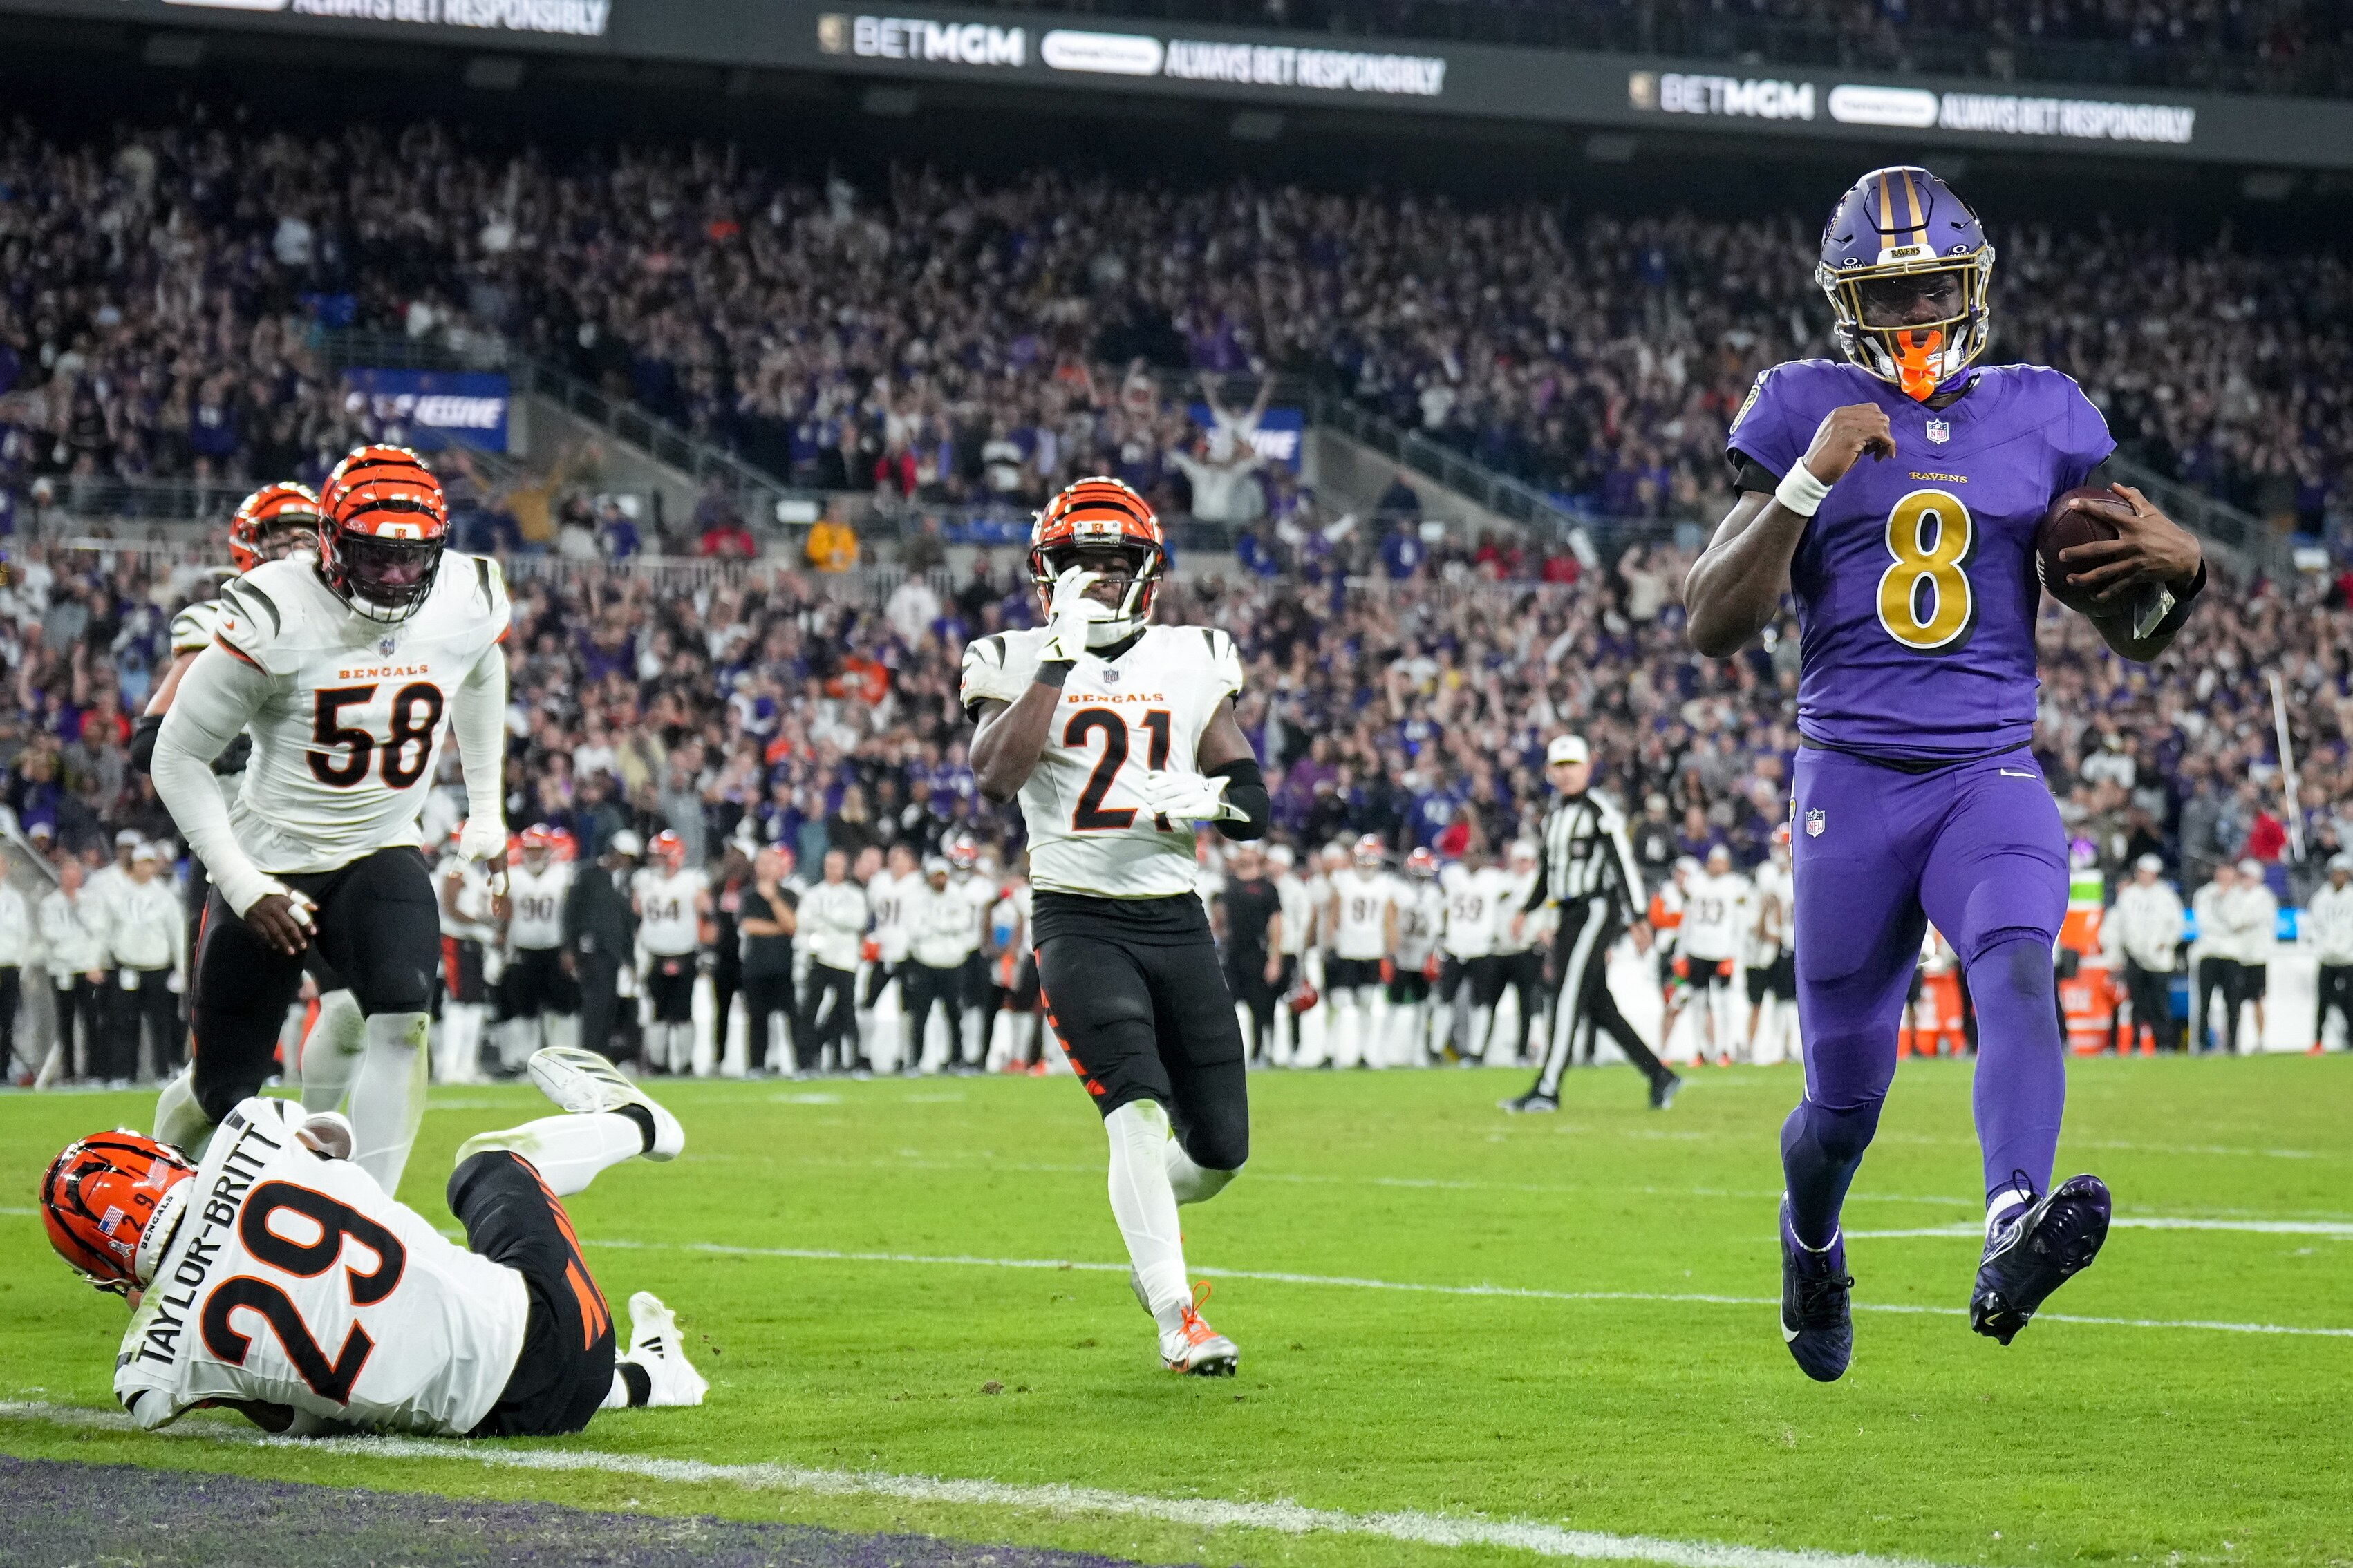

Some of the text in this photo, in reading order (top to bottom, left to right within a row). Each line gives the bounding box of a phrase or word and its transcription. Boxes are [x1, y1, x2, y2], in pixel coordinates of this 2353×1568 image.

[853, 15, 1026, 67] BETMGM
[1253, 44, 1297, 86] BET
[1297, 48, 1446, 95] RESPONSIBLY
[1660, 73, 1815, 121] BETMGM
[1891, 247, 1921, 258] RAVENS
[1909, 471, 1968, 484] RAVENS
[1876, 489, 1975, 651] 8
[339, 665, 429, 679] BENGALS
[1067, 693, 1164, 703] BENGALS
[306, 681, 444, 790] 58
[1062, 707, 1174, 833] 21
[122, 1193, 156, 1233] 29
[140, 1195, 174, 1250] BENGALS
[135, 1122, 282, 1366] TAYLOR-BRITT
[200, 1180, 406, 1406] 29
